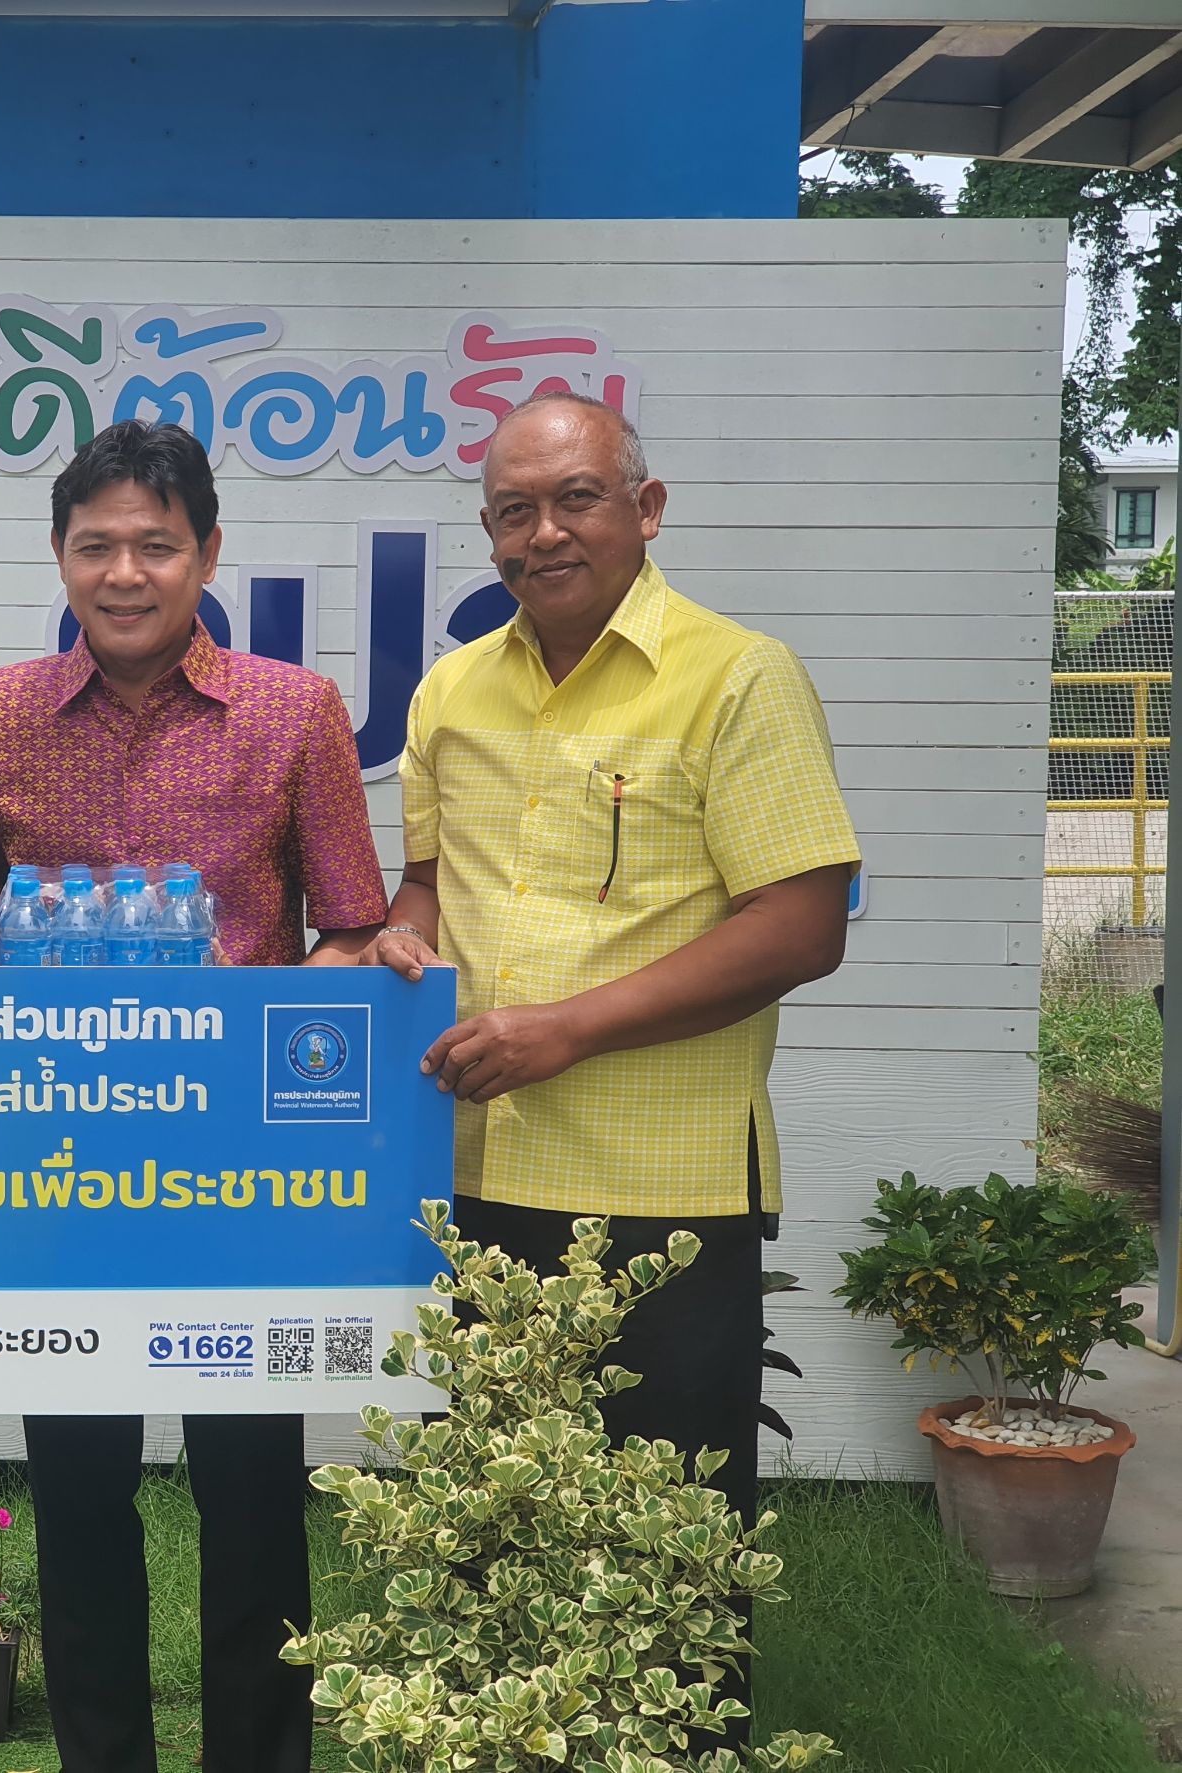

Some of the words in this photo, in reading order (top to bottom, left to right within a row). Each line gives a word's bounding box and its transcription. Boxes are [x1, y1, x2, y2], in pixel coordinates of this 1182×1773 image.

[274, 1090, 361, 1102] การประปาส่วนภูมิภาค
[269, 1317, 314, 1326] Application
[345, 1316, 373, 1324] Official
[149, 1323, 173, 1331] PWA
[177, 1323, 216, 1331] Contact
[220, 1323, 255, 1331] Center
[178, 1336, 254, 1360] 1662
